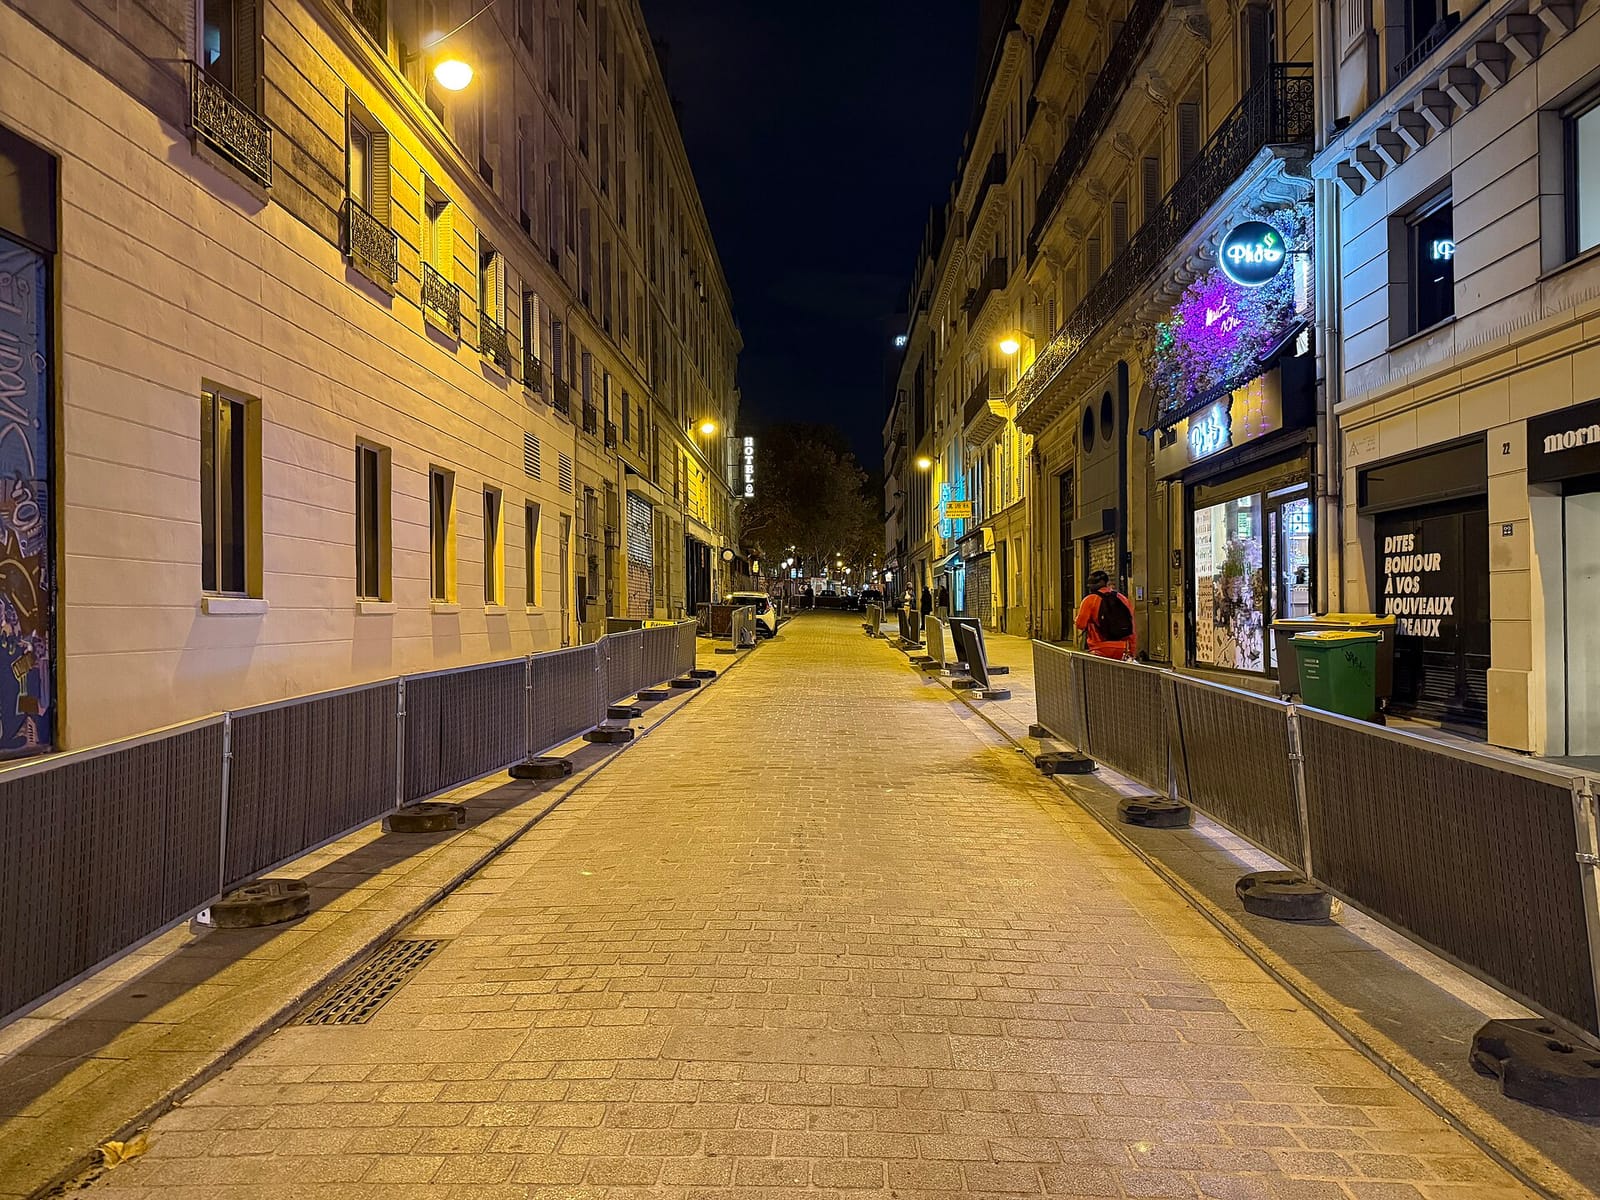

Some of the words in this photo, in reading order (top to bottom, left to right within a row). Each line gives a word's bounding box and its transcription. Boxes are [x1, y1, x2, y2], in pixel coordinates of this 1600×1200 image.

[1502, 442, 1511, 455] 22
[744, 436, 754, 484] HOTEL
[1384, 534, 1415, 554] DITES
[1384, 553, 1441, 574] BONJOUR
[1384, 573, 1394, 594] À
[1395, 576, 1421, 594] VOS
[1384, 597, 1455, 616] NOUVEAUX
